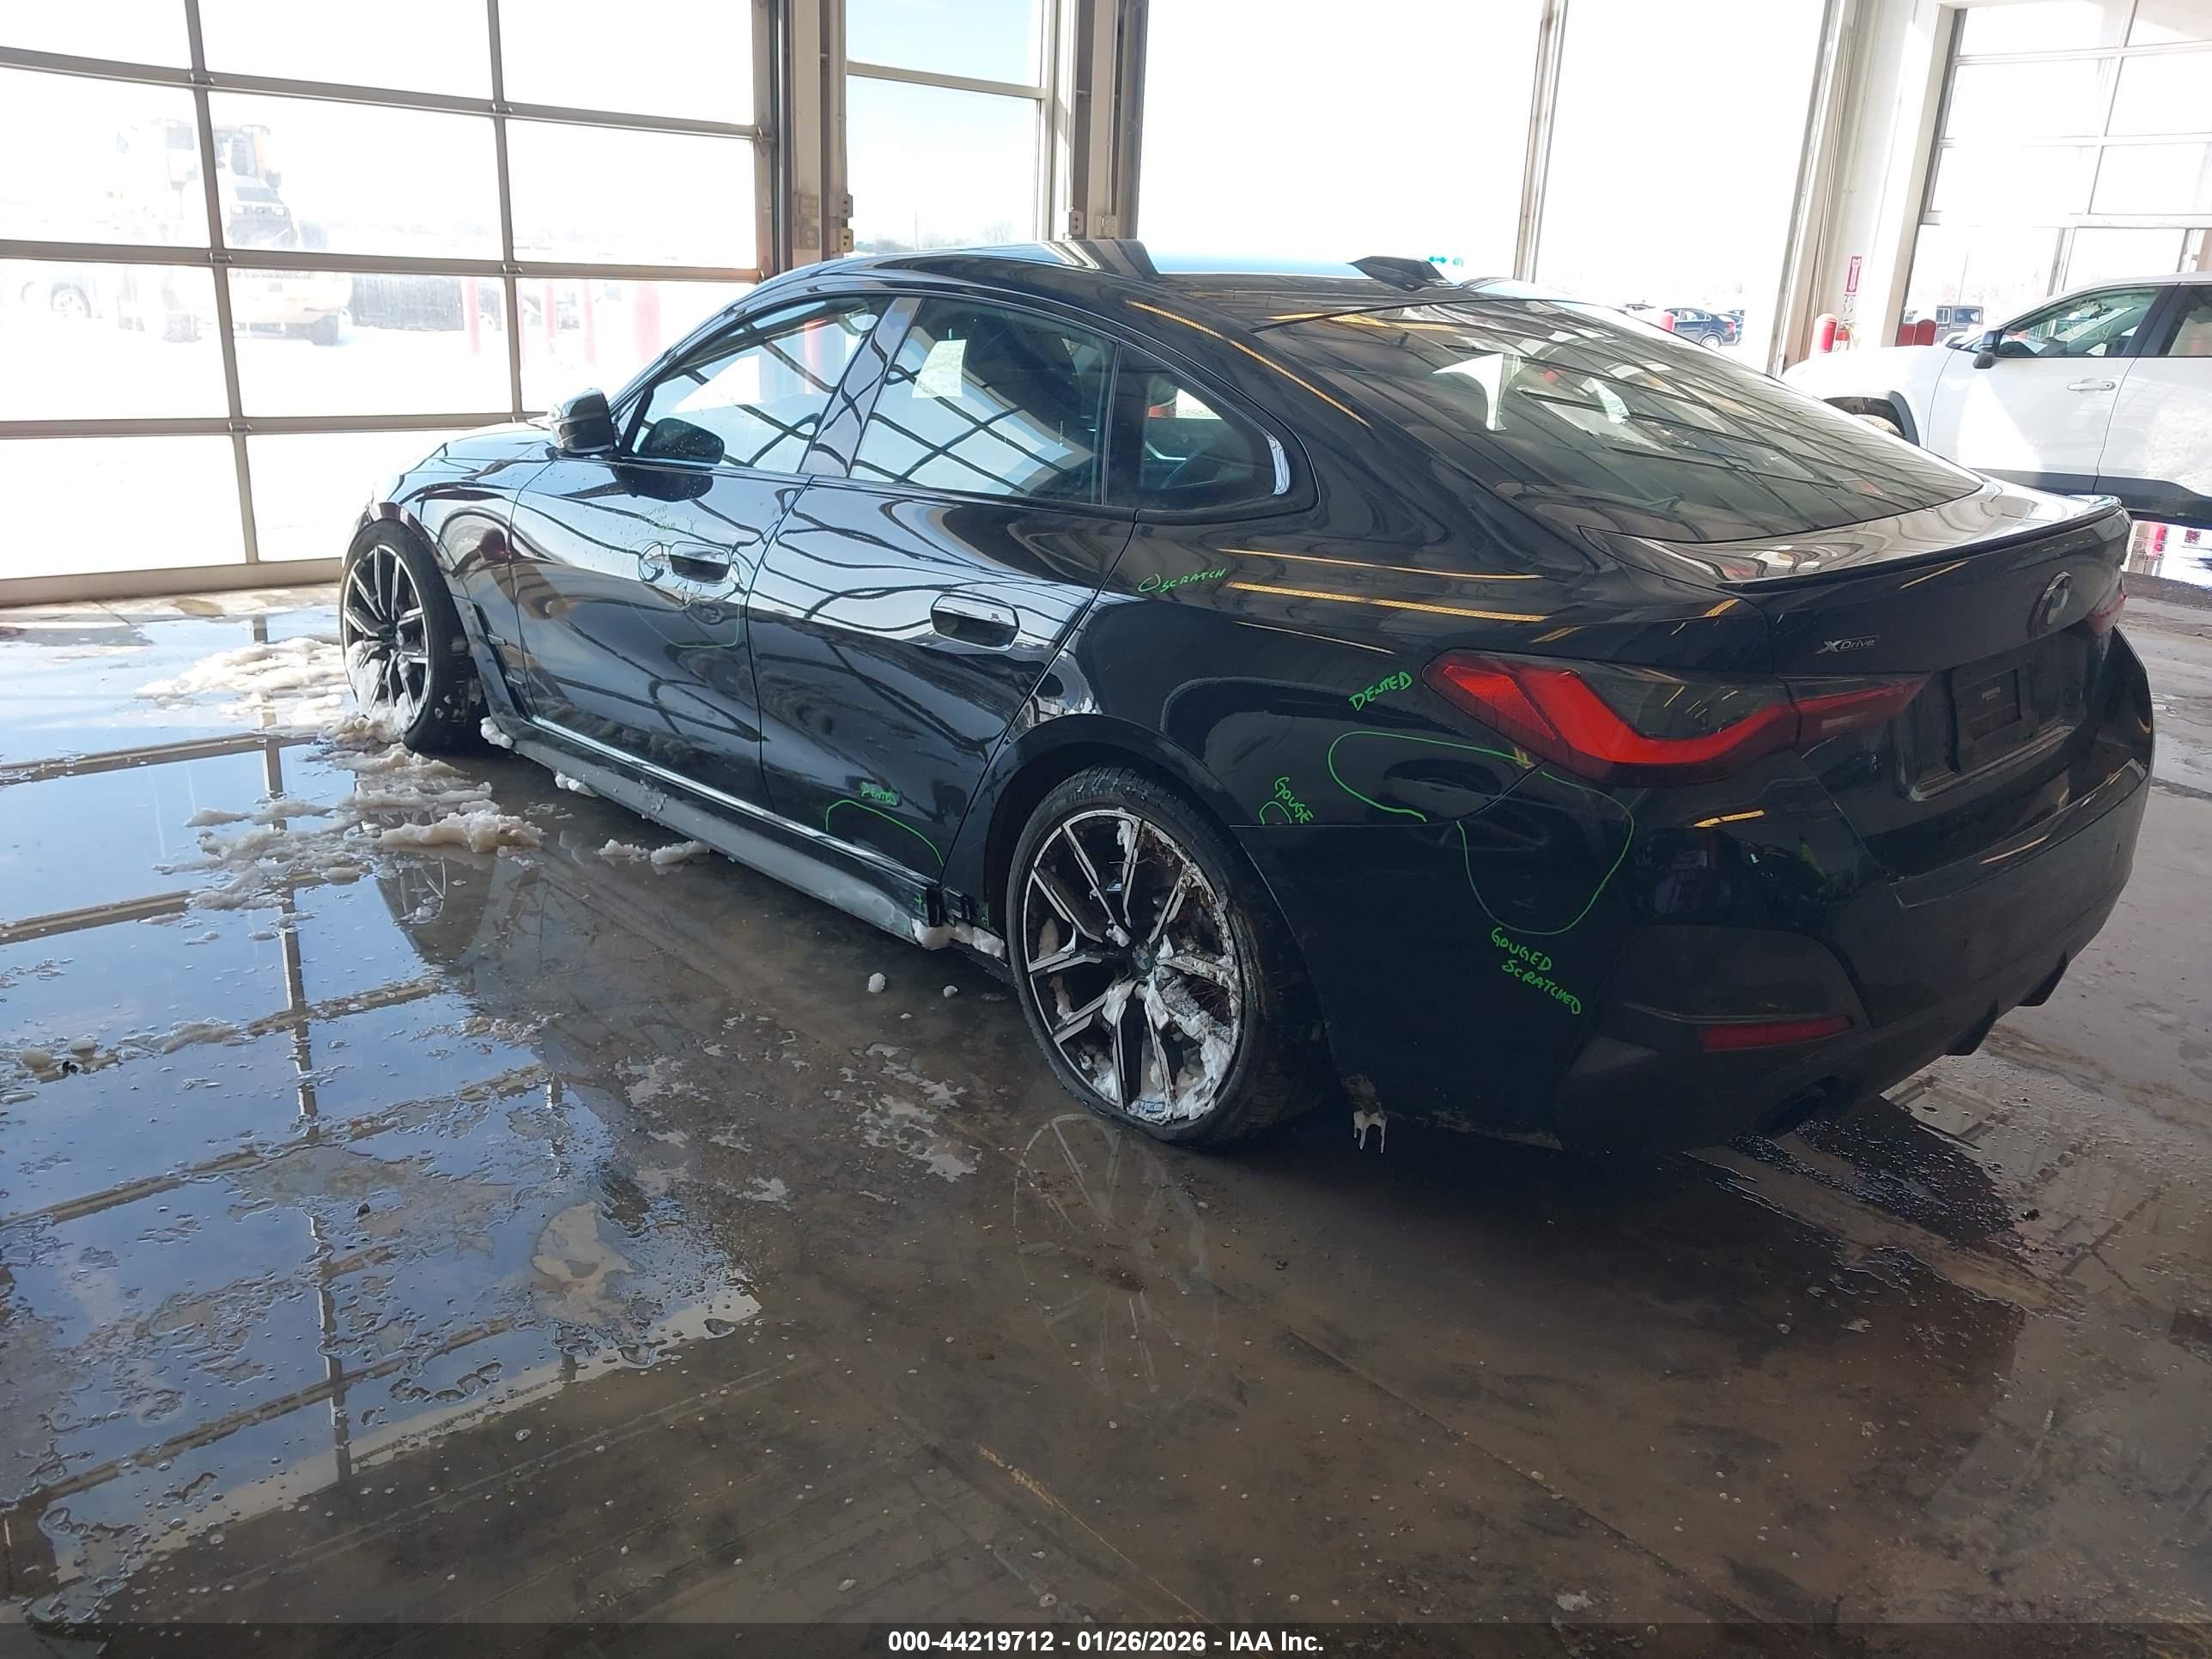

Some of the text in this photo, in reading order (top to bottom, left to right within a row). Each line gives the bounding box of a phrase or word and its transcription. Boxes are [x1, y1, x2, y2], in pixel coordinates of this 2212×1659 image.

[1159, 568, 1226, 592] SCRATCH
[1348, 672, 1413, 711] DENTED
[1274, 776, 1314, 824] GOUGE
[1491, 927, 1553, 971] GOUGED
[1501, 959, 1582, 1015] SCRATCHED
